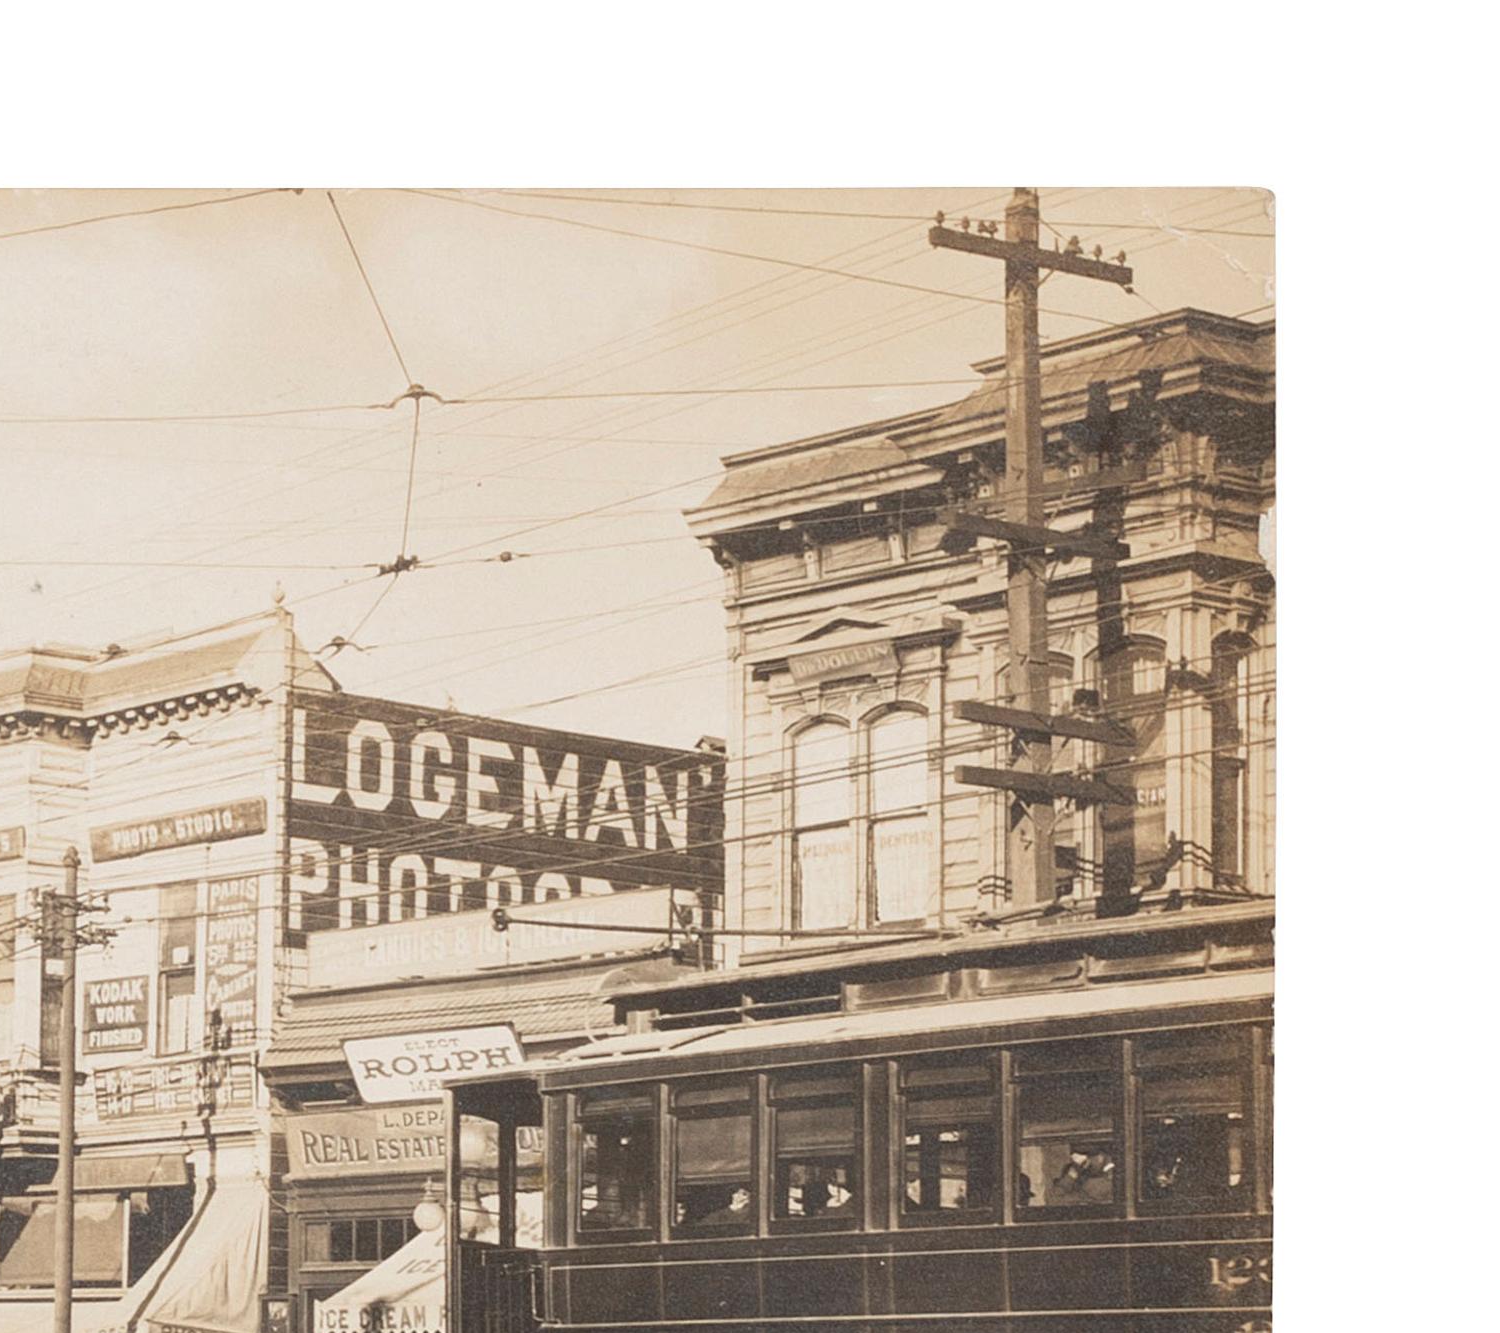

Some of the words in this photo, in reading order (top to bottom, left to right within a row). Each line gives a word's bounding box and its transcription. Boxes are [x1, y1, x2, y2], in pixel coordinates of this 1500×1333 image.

[88, 979, 144, 1005] KODAK
[95, 1004, 137, 1025] WORK
[88, 1027, 144, 1049] FINISHED
[403, 1037, 461, 1052] ELECT
[358, 1046, 516, 1080] ROLPH
[301, 1129, 369, 1165] REAL
[375, 1135, 446, 1161] ESTATE
[318, 1307, 350, 1330] ICE
[358, 1304, 427, 1330] CREAM
